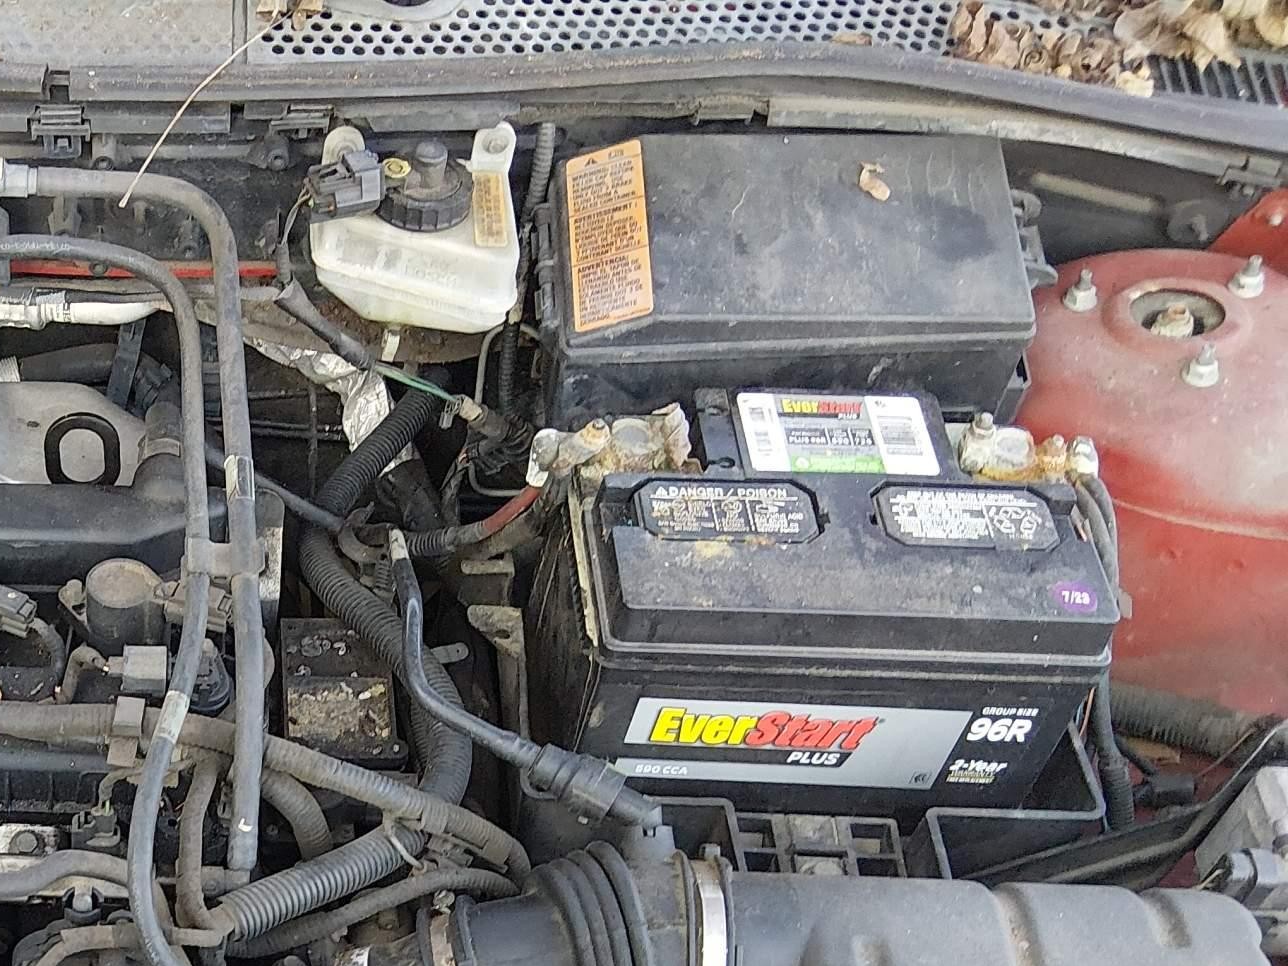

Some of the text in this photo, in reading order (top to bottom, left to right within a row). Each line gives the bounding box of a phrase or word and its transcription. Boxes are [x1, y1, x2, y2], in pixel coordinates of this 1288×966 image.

[838, 412, 858, 420] PLUS
[669, 486, 723, 497] DANGER
[737, 488, 788, 498] POISON
[982, 706, 1016, 716] GROUP
[649, 707, 878, 751] EverStart
[966, 717, 1032, 743] 96R
[786, 751, 841, 766] PLUS
[662, 765, 688, 775] CCA
[949, 758, 1008, 773] 2-Year
